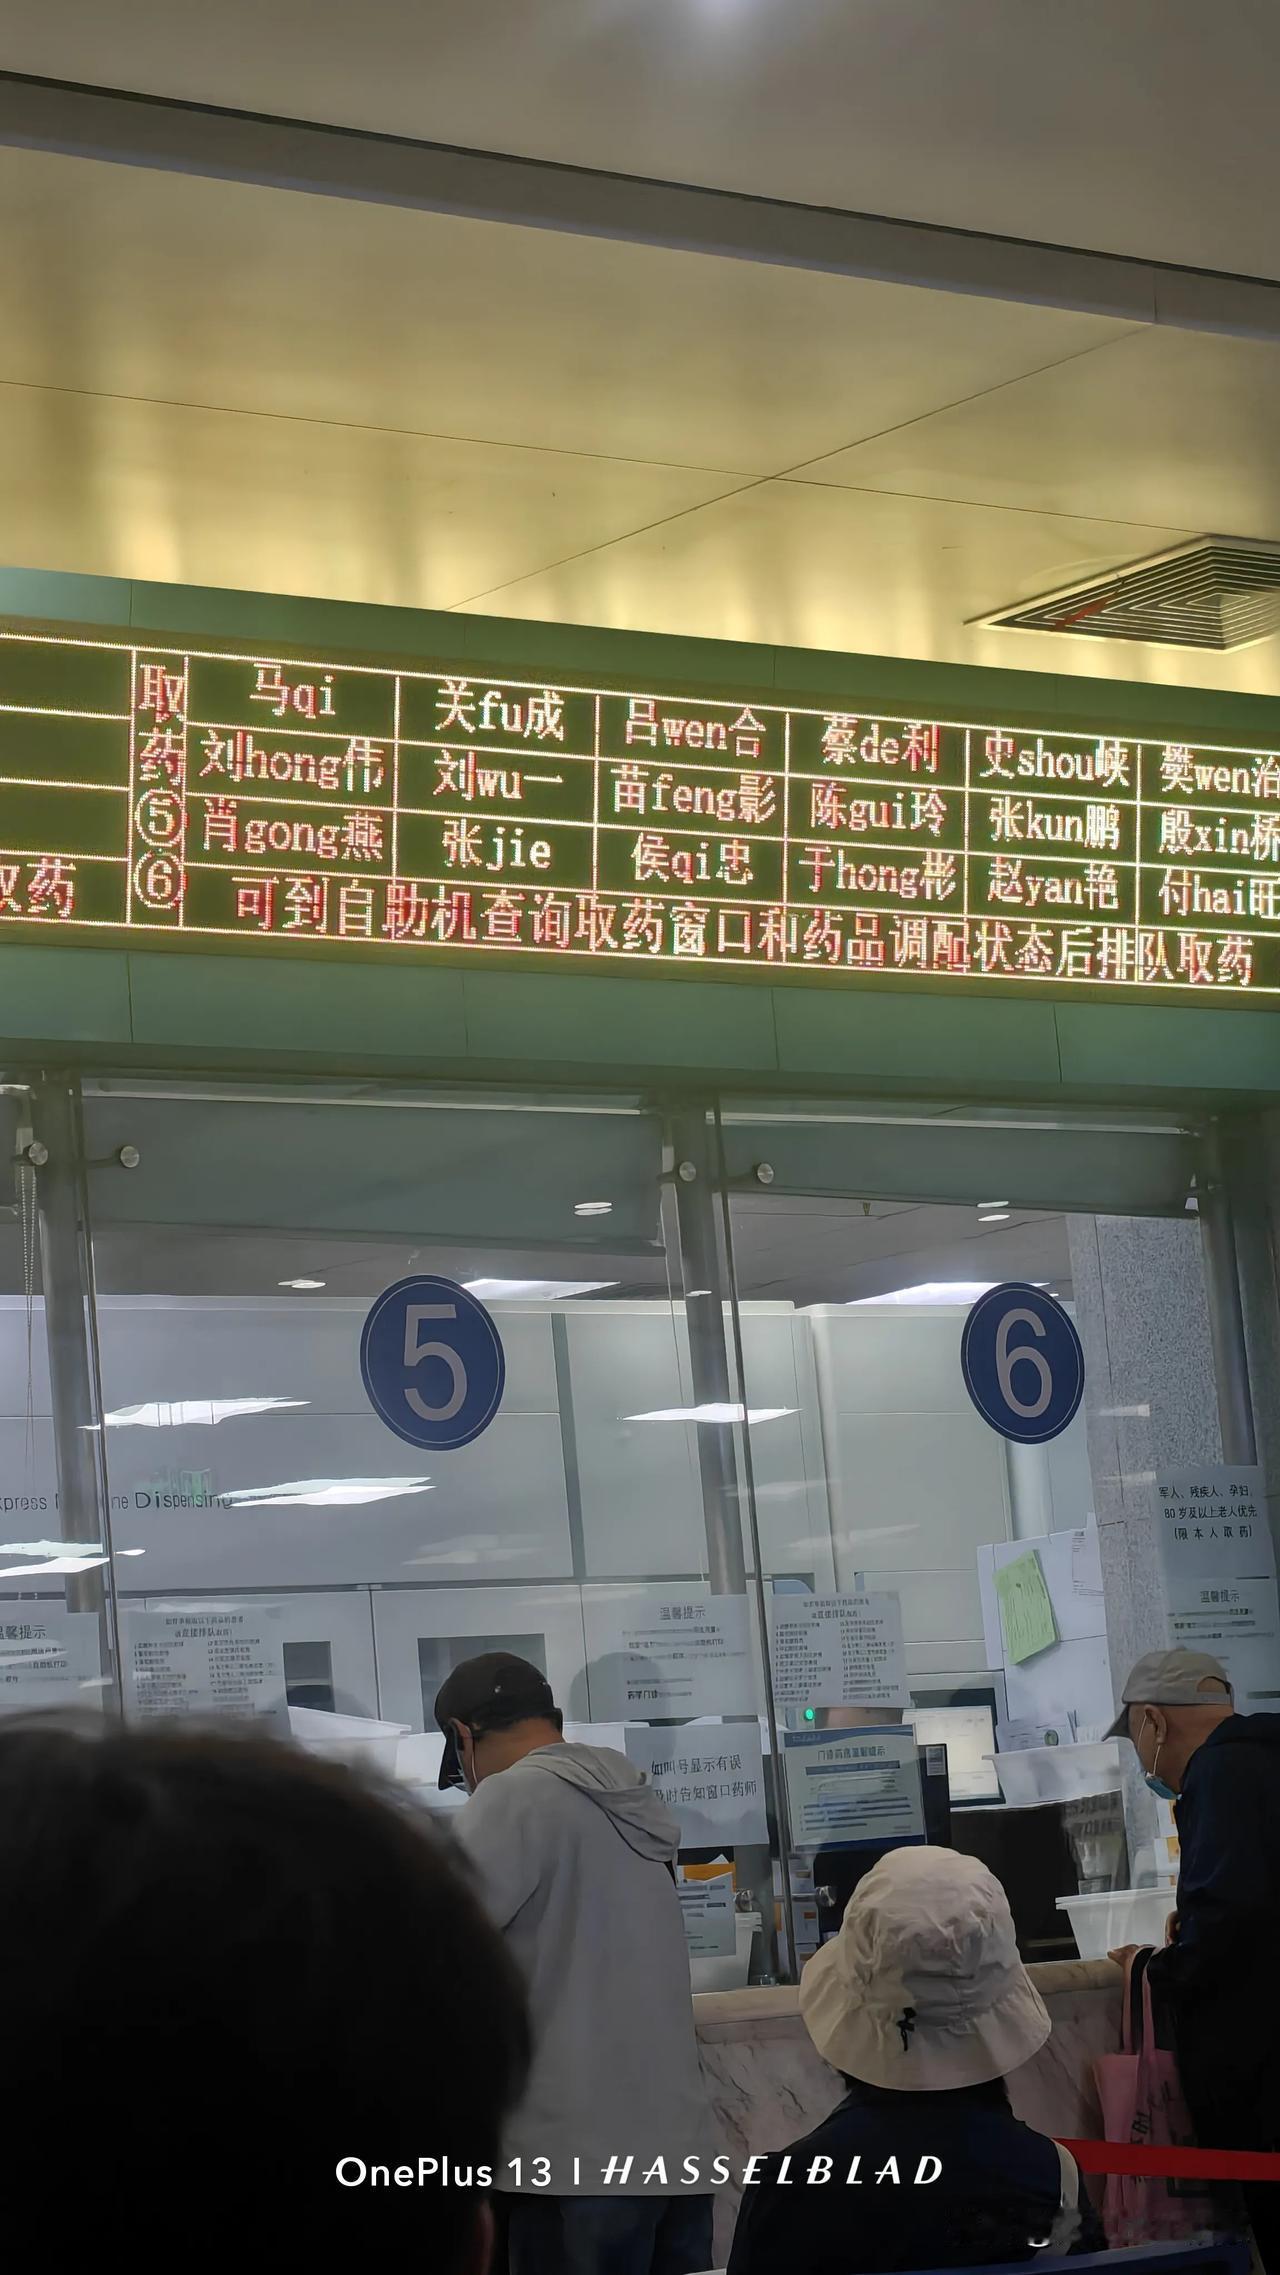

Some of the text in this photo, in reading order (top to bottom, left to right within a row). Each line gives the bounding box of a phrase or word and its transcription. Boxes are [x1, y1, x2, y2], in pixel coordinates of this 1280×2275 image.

[250, 662, 335, 719] 马qi
[435, 679, 564, 742] 关fu成
[625, 698, 766, 758] 吕wen合
[822, 714, 939, 774] 蔡de利
[200, 728, 386, 793] 刘hong伟
[433, 749, 563, 801] 刘wu一
[610, 764, 777, 824] 苗feng影
[811, 781, 947, 837] 陈gui玲
[990, 795, 1120, 850] 张kun鹏
[203, 797, 383, 862] 肖gong燕
[442, 818, 551, 871] 张jie
[630, 831, 753, 885] 侯qi忠
[799, 847, 956, 902] 于hong彬
[987, 856, 1119, 911] 赵yan艳
[231, 876, 1254, 986] 可到自助机查询取药窗口和药品调配状态后排队取药
[403, 1303, 469, 1422] 5
[994, 1309, 1053, 1419] 6
[659, 1605, 706, 1621] 温馨提示
[651, 1754, 742, 1776] 如叫号显示有误
